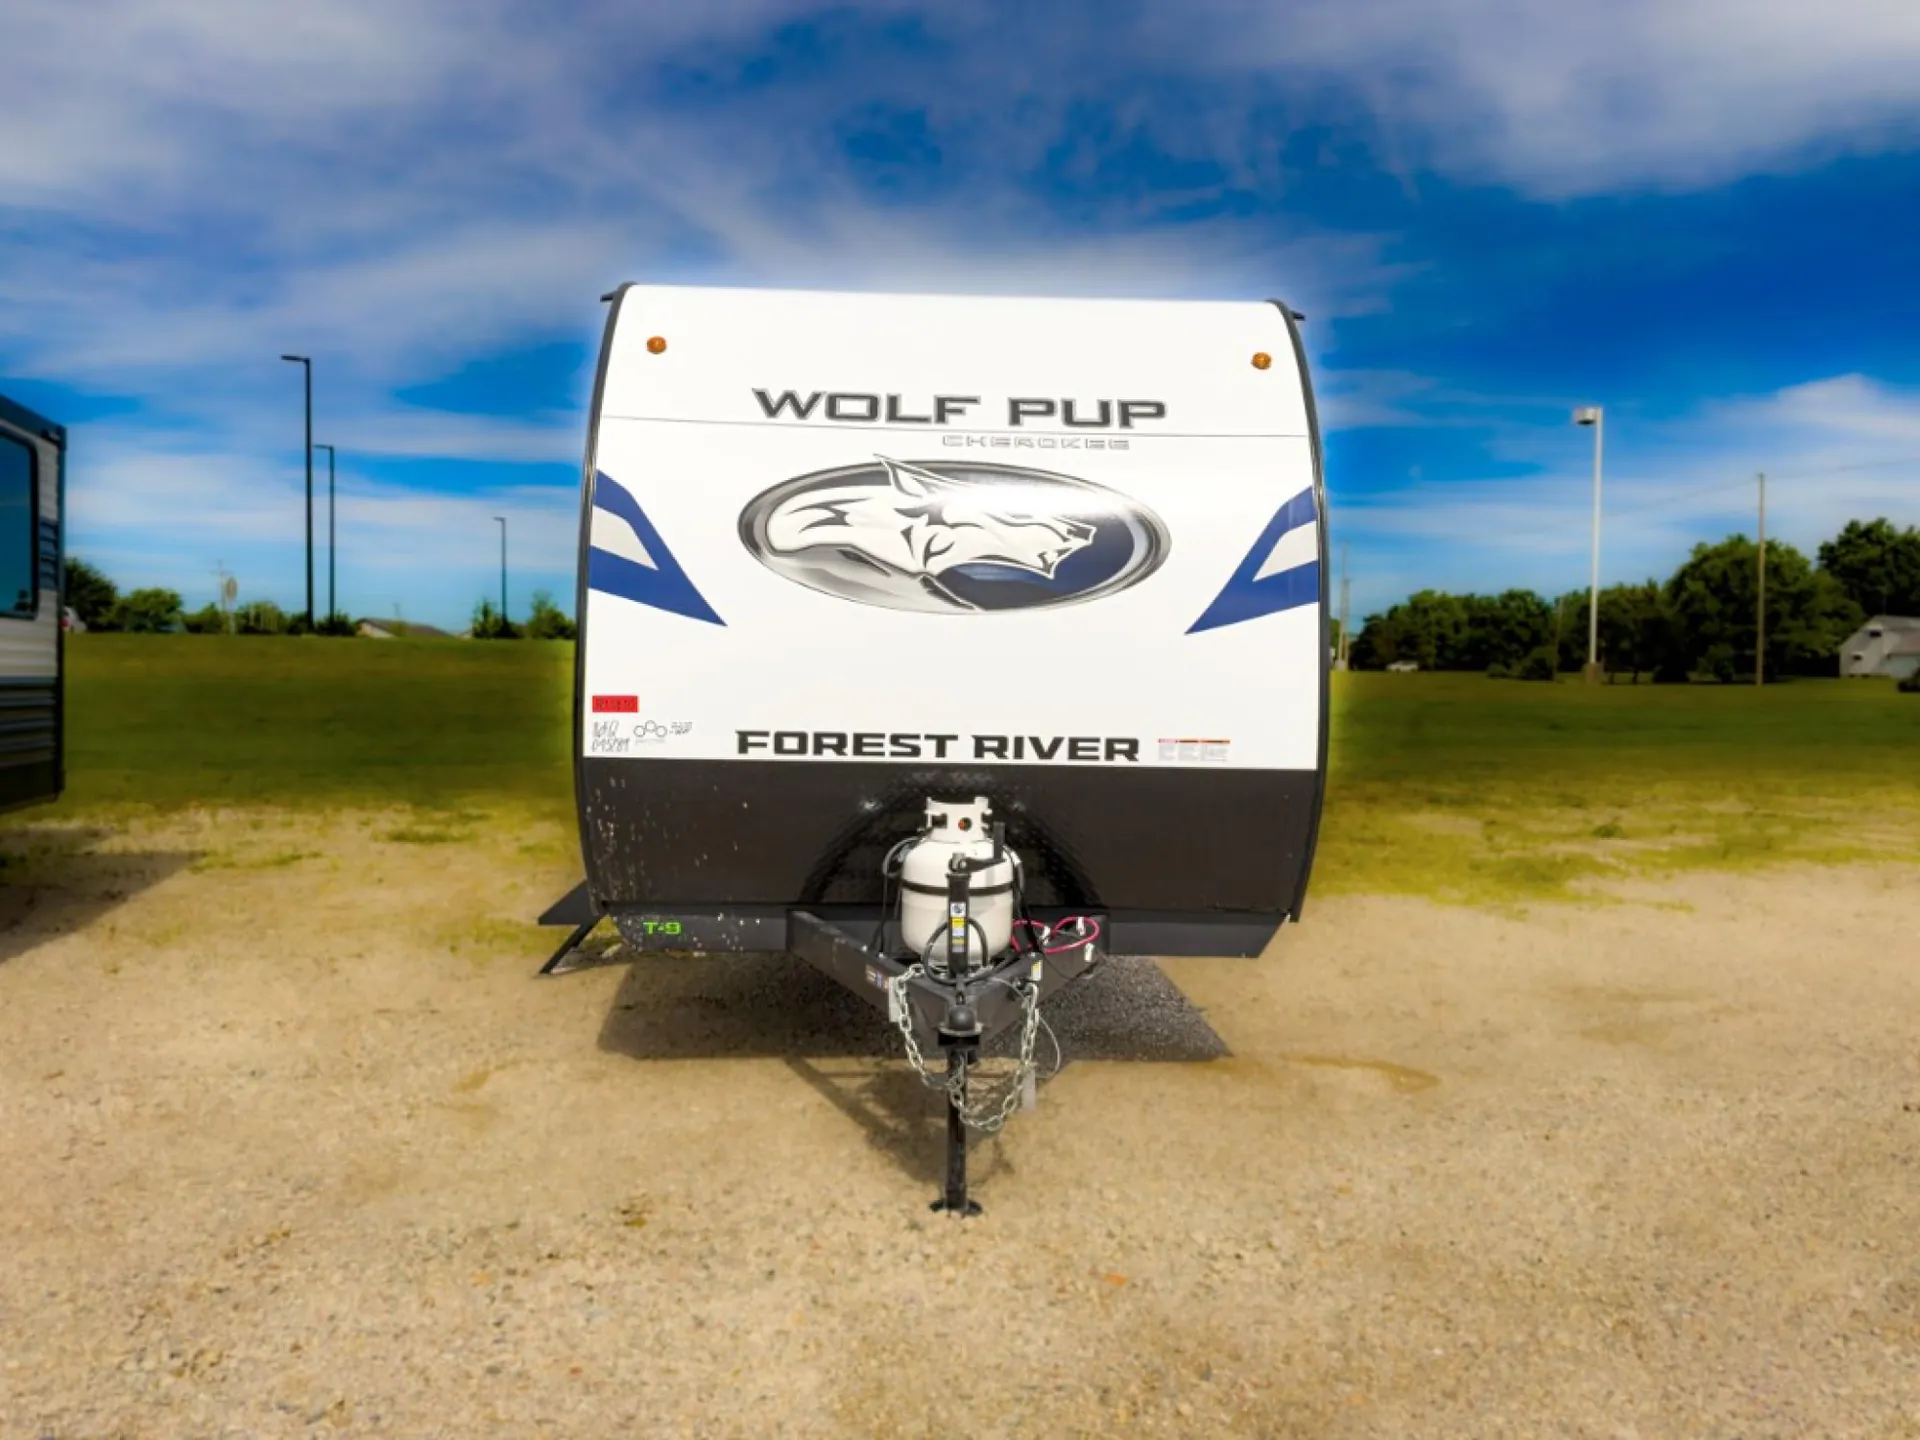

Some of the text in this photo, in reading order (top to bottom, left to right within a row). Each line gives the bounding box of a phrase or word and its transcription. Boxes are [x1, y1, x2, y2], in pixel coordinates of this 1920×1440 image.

[753, 388, 1166, 428] WOLF PUP
[942, 435, 1130, 451] CHEROKEE
[736, 730, 958, 757] FOREST
[971, 735, 1139, 762] RIVER
